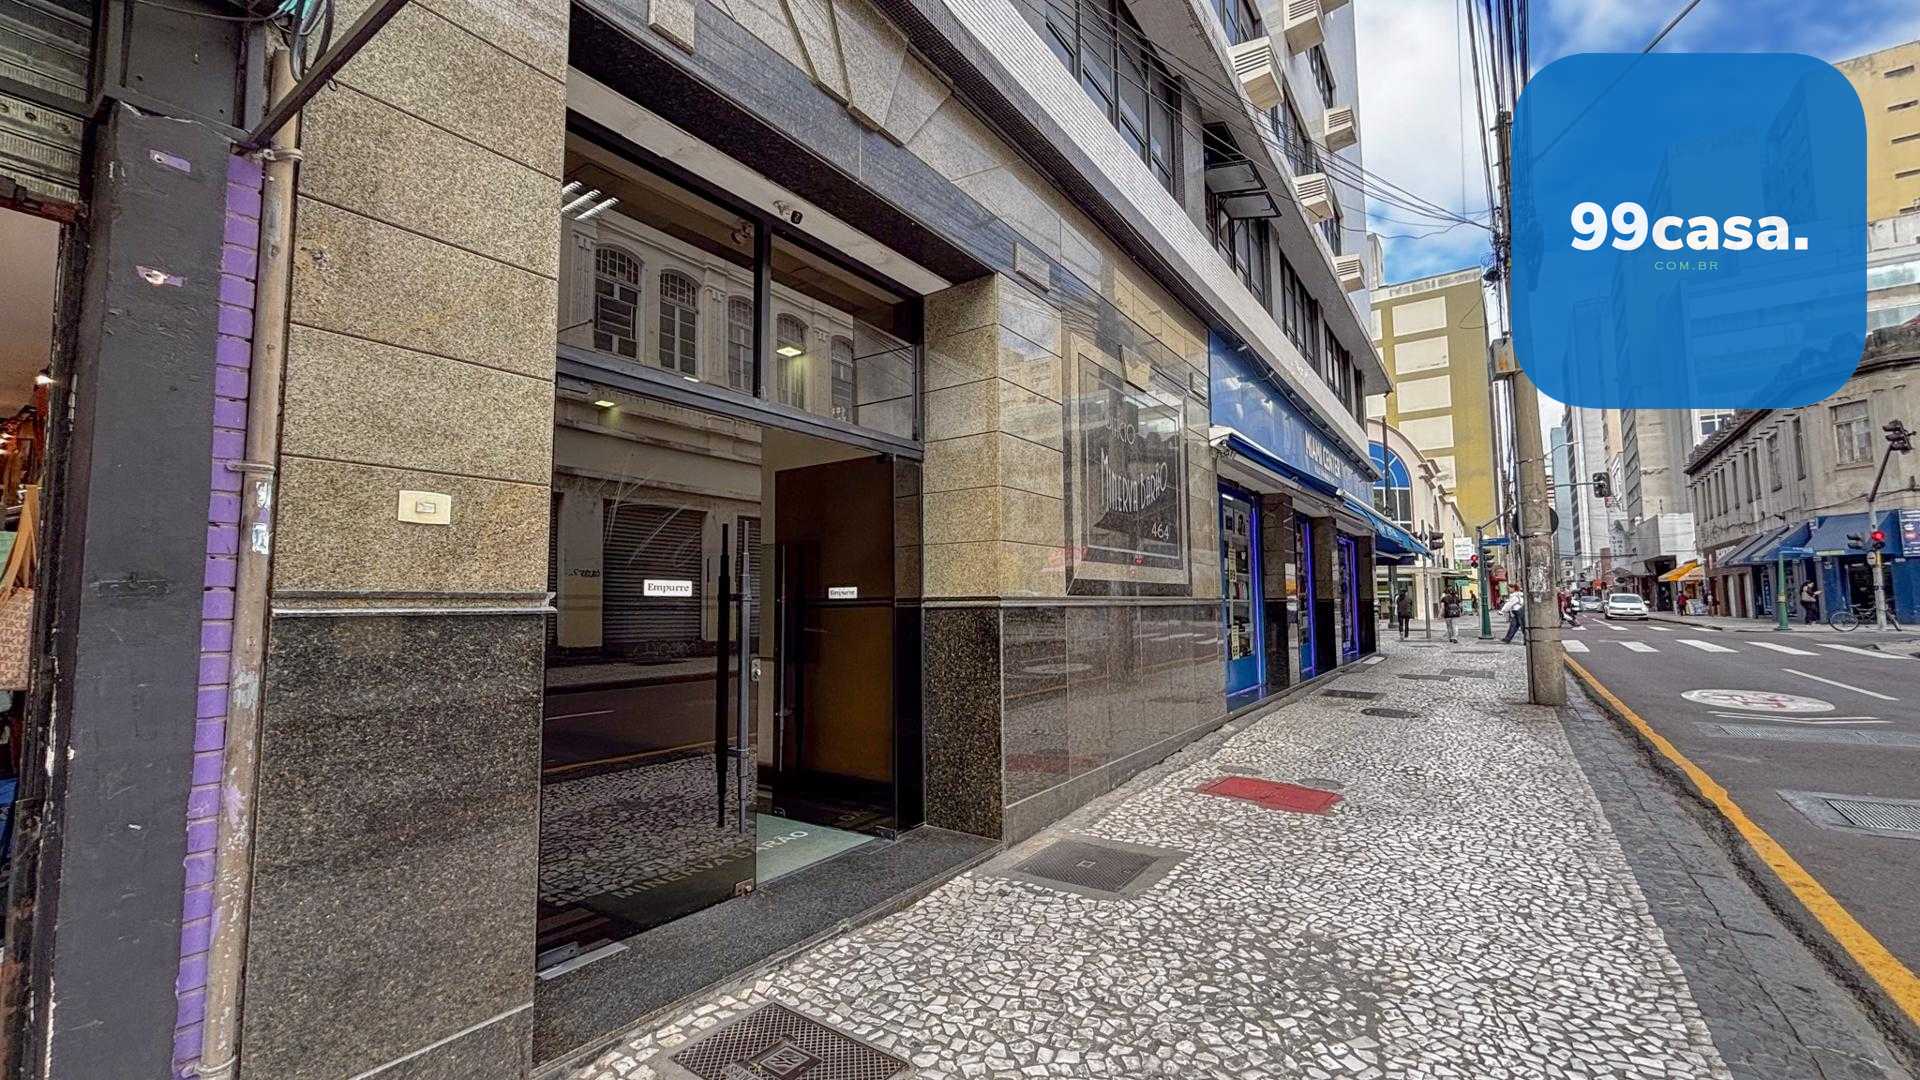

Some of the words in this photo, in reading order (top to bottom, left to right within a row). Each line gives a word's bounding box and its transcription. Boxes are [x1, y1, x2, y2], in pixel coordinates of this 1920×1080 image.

[1151, 522, 1169, 540] 464
[648, 583, 690, 594] Empurre
[613, 857, 733, 899] MINERVA
